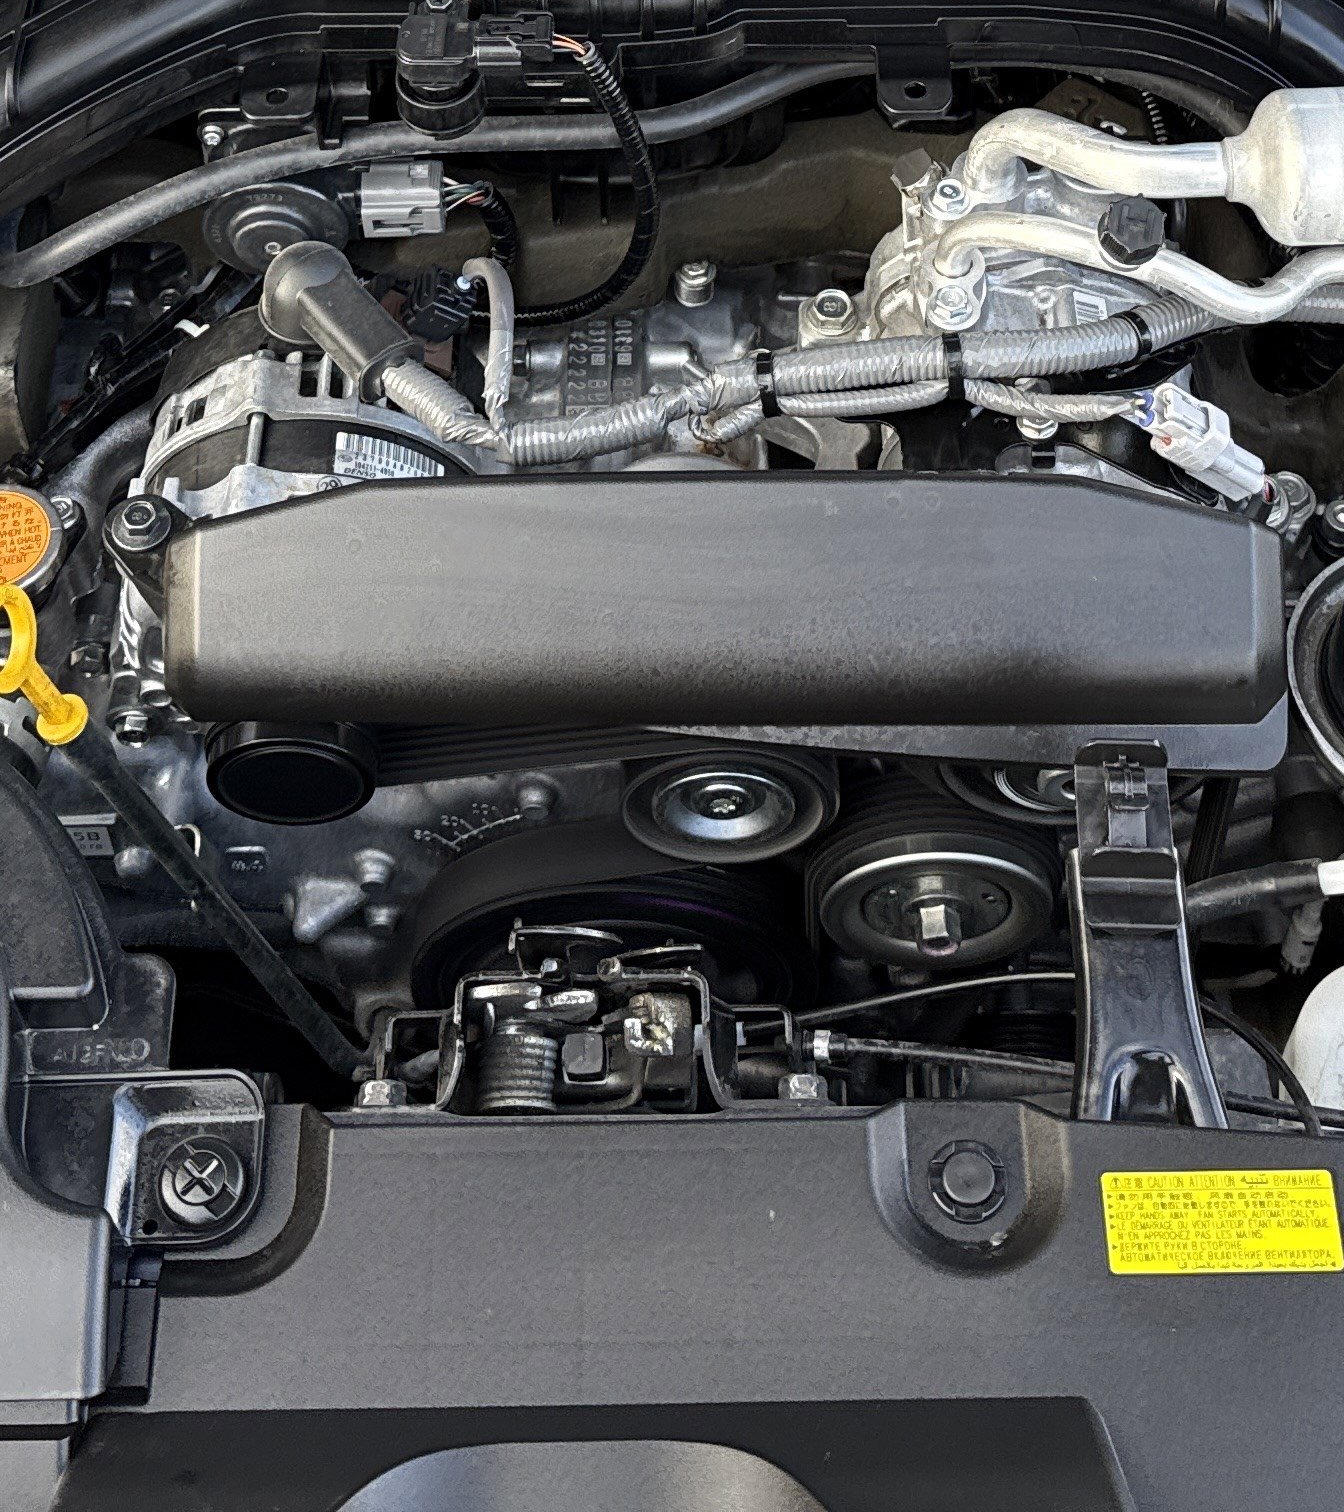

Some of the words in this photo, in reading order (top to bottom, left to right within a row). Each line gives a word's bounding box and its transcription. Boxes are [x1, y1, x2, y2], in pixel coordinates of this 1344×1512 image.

[344, 468, 376, 479] DENSO
[17, 534, 42, 545] CHAUD
[1147, 1175, 1184, 1188] CAUTION
[1189, 1175, 1235, 1188] ATTENTION
[1116, 1211, 1135, 1220] KEEP
[1139, 1211, 1165, 1220] HANDS
[1197, 1211, 1214, 1219] FAN
[1218, 1210, 1247, 1219] STARTS
[1116, 1221, 1126, 1230] LE
[1177, 1220, 1188, 1230] DU
[1191, 1219, 1244, 1230] VENTILATEUR
[1144, 1230, 1190, 1240] APPROCHEZ
[1195, 1230, 1211, 1240] PAS
[1215, 1230, 1232, 1240] LES
[1164, 1242, 1188, 1250] РУКИ
